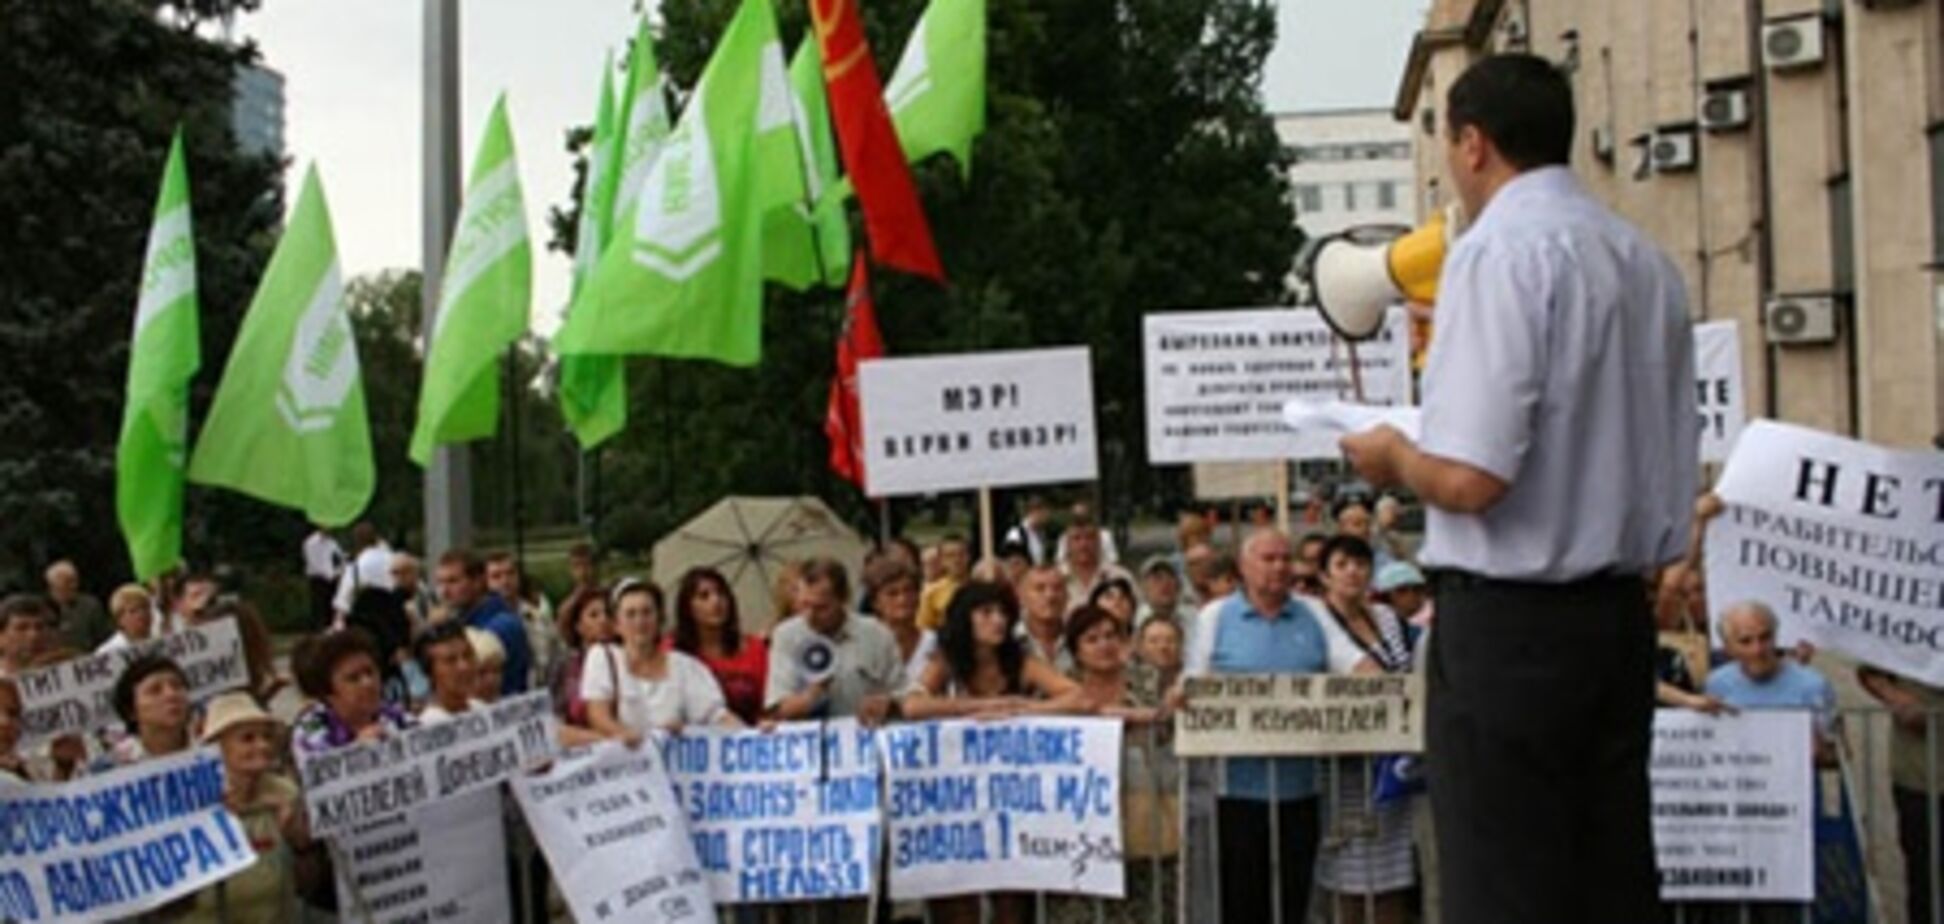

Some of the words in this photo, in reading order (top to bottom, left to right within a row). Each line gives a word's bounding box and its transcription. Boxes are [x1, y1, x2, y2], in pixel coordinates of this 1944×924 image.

[942, 383, 1019, 412] МЭР!
[1739, 537, 1944, 609] ПОВЫШЕ
[0, 756, 223, 857] СОРОСЖИГАНИЕ
[988, 771, 1047, 813] ПОД
